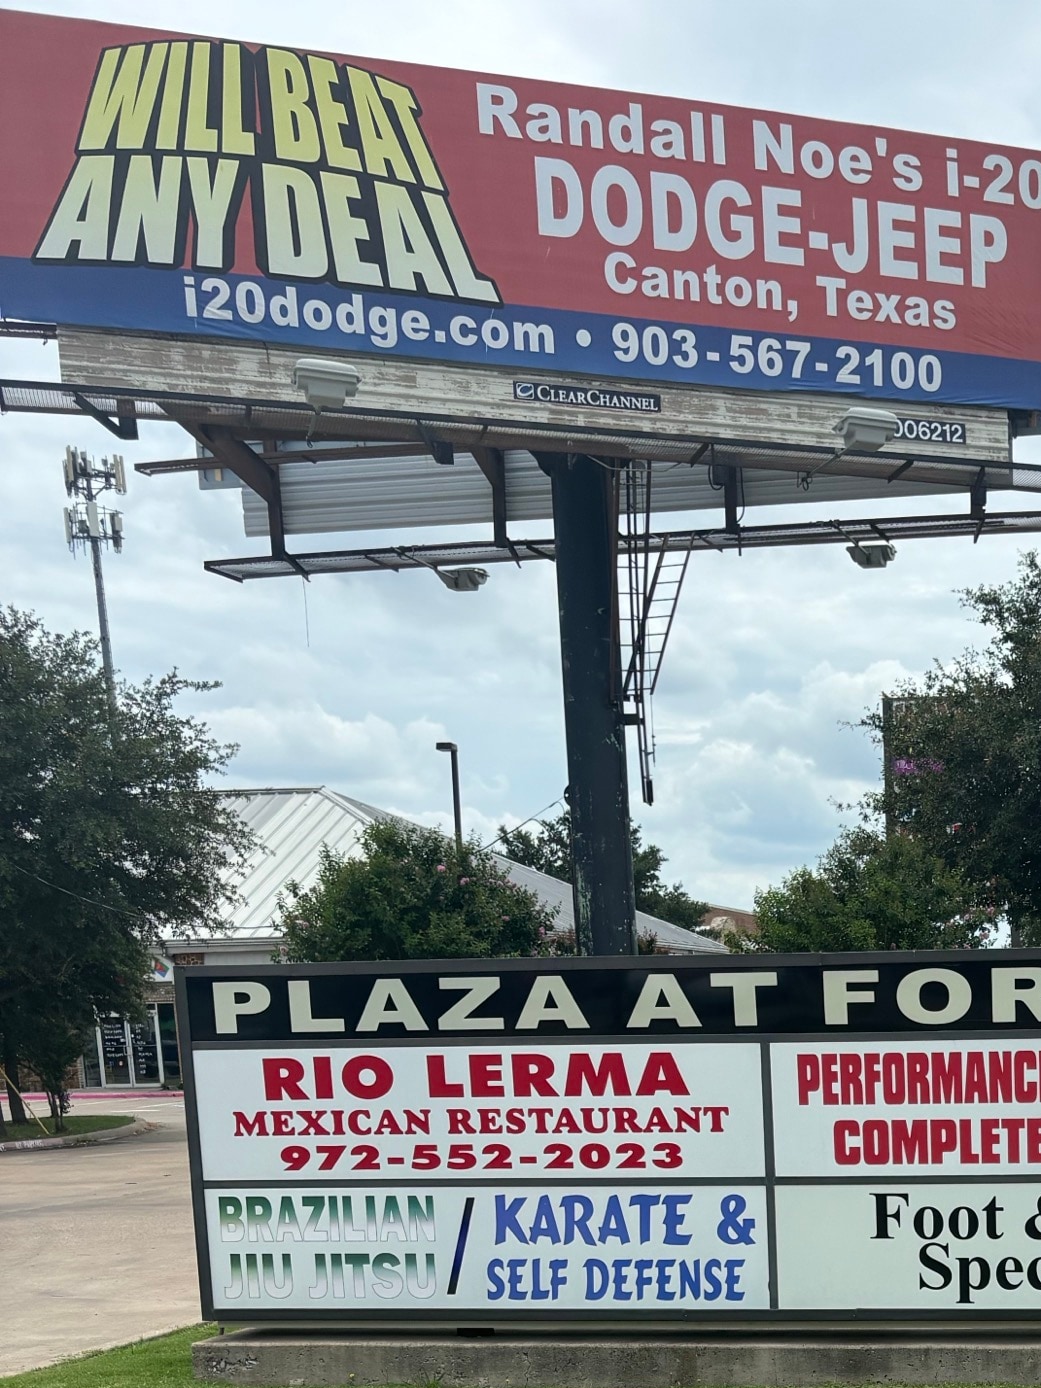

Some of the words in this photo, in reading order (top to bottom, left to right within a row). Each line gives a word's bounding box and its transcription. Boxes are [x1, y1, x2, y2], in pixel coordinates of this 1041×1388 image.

[78, 41, 255, 156] WILL
[266, 46, 445, 192] BEAT
[475, 82, 727, 166] Randall
[753, 120, 924, 193] Noe's
[36, 155, 240, 268] ANY
[262, 163, 501, 303] DEAL
[533, 155, 1009, 289] DODGE-JEEP
[183, 275, 556, 355] i20dodge.com
[604, 251, 799, 322] Canton,
[816, 276, 957, 331] Texas
[211, 975, 591, 1034] PLAZA
[626, 971, 778, 1028] AT
[262, 1054, 394, 1101] RIO
[426, 1051, 691, 1098] LERMA
[232, 1107, 432, 1138] MEXICAN
[446, 1106, 730, 1136] RESTAURANT
[280, 1141, 684, 1171] 972-552-2023
[218, 1194, 437, 1244] BRAZILIAN
[493, 1193, 694, 1247] KARATE
[716, 1194, 757, 1246] &
[868, 1191, 1005, 1241] Foot
[222, 1252, 295, 1301] JIU
[307, 1252, 437, 1301] JITSU
[486, 1257, 569, 1302] SELF
[584, 1257, 747, 1302] DEFENSE
